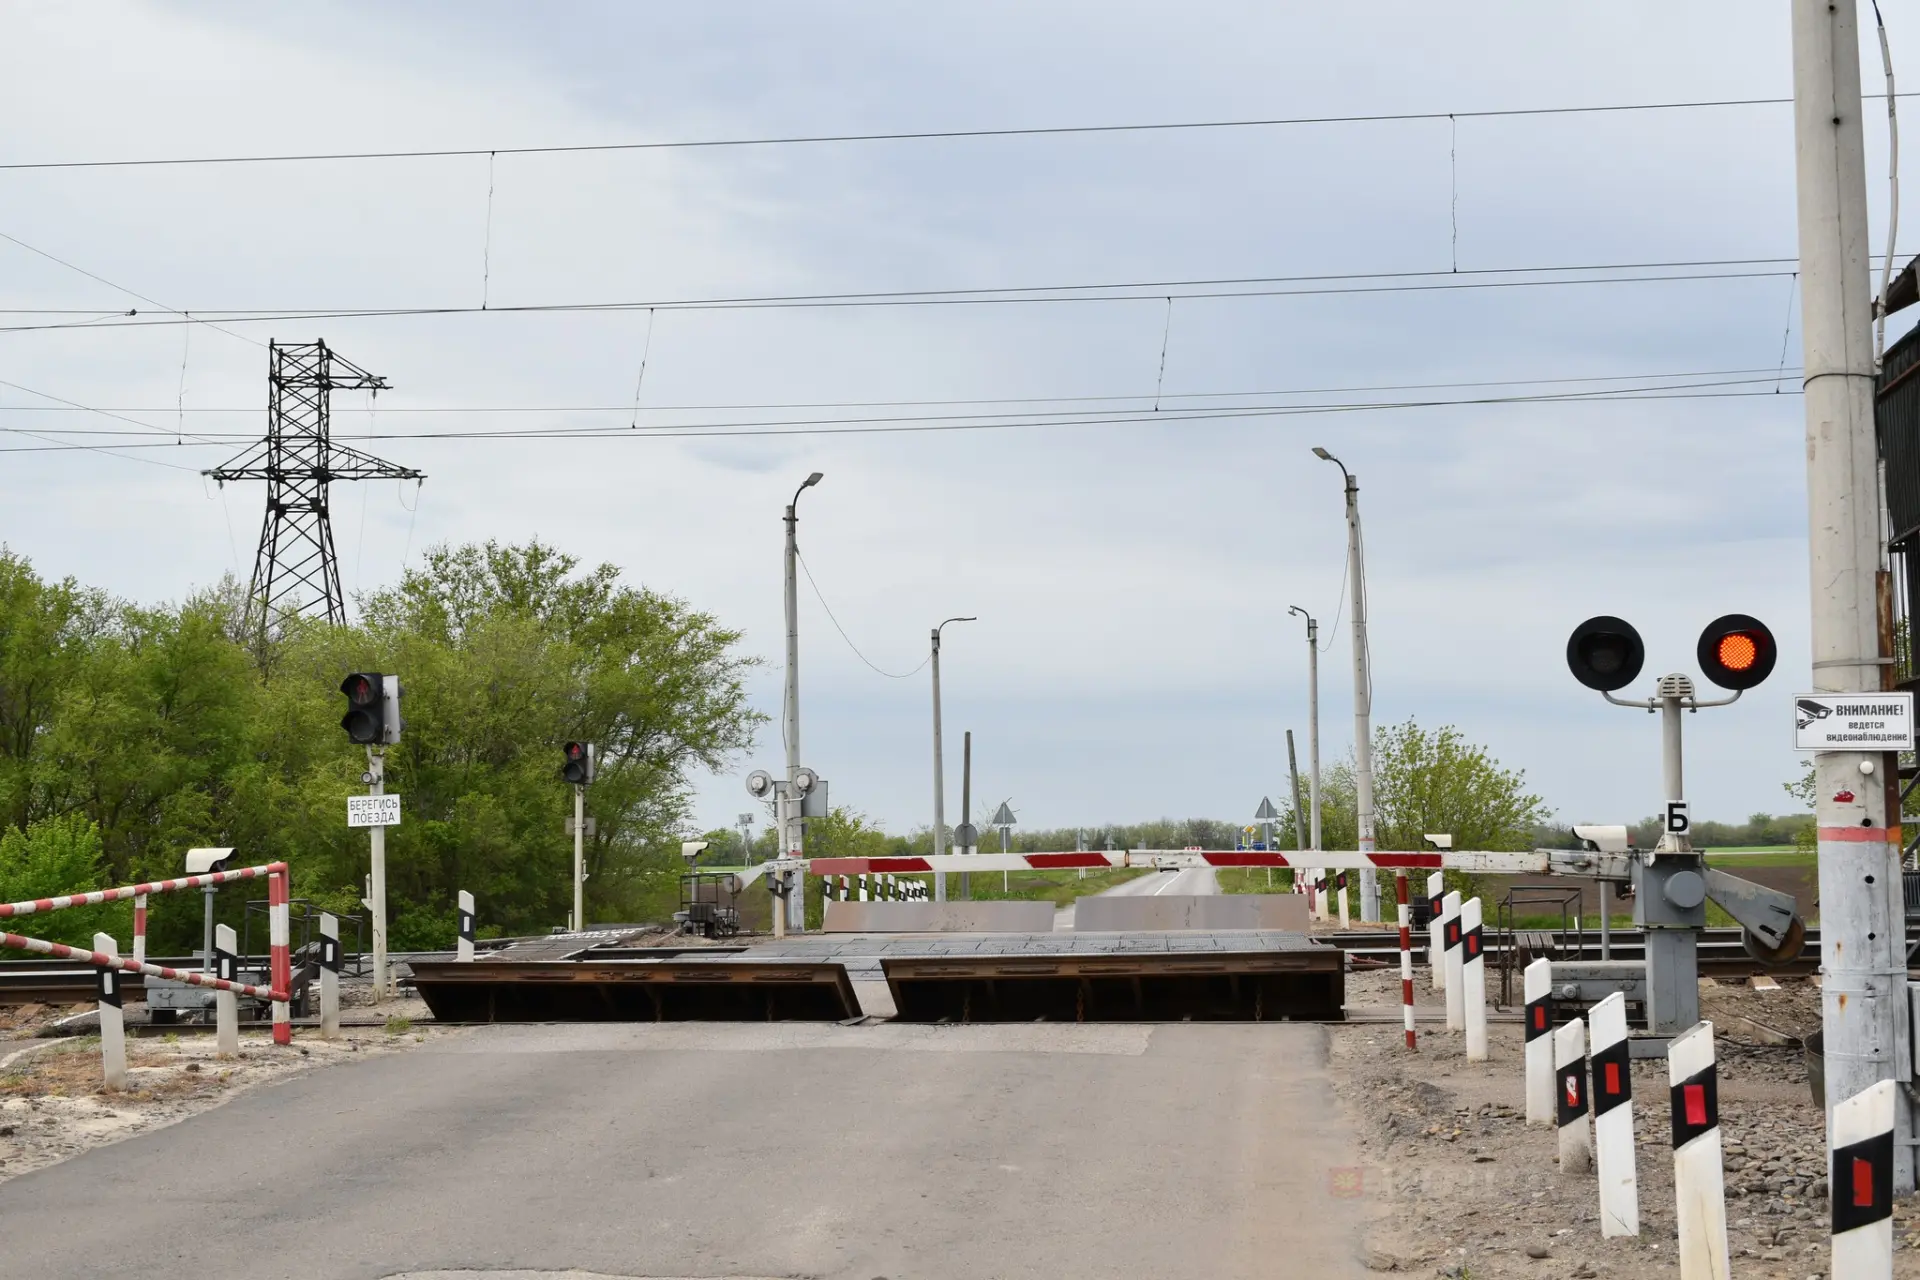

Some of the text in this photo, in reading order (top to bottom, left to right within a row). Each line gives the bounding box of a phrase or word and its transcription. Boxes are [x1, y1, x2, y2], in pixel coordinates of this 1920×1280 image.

[1836, 704, 1904, 716] ВНИМАНИЕ!
[1848, 721, 1885, 730] ведется
[1826, 732, 1908, 742] видеонаблюдение
[350, 798, 398, 811] БЕРЕГИСЬ
[353, 812, 395, 824] ПОЕЗДА
[1668, 803, 1688, 832] Б
